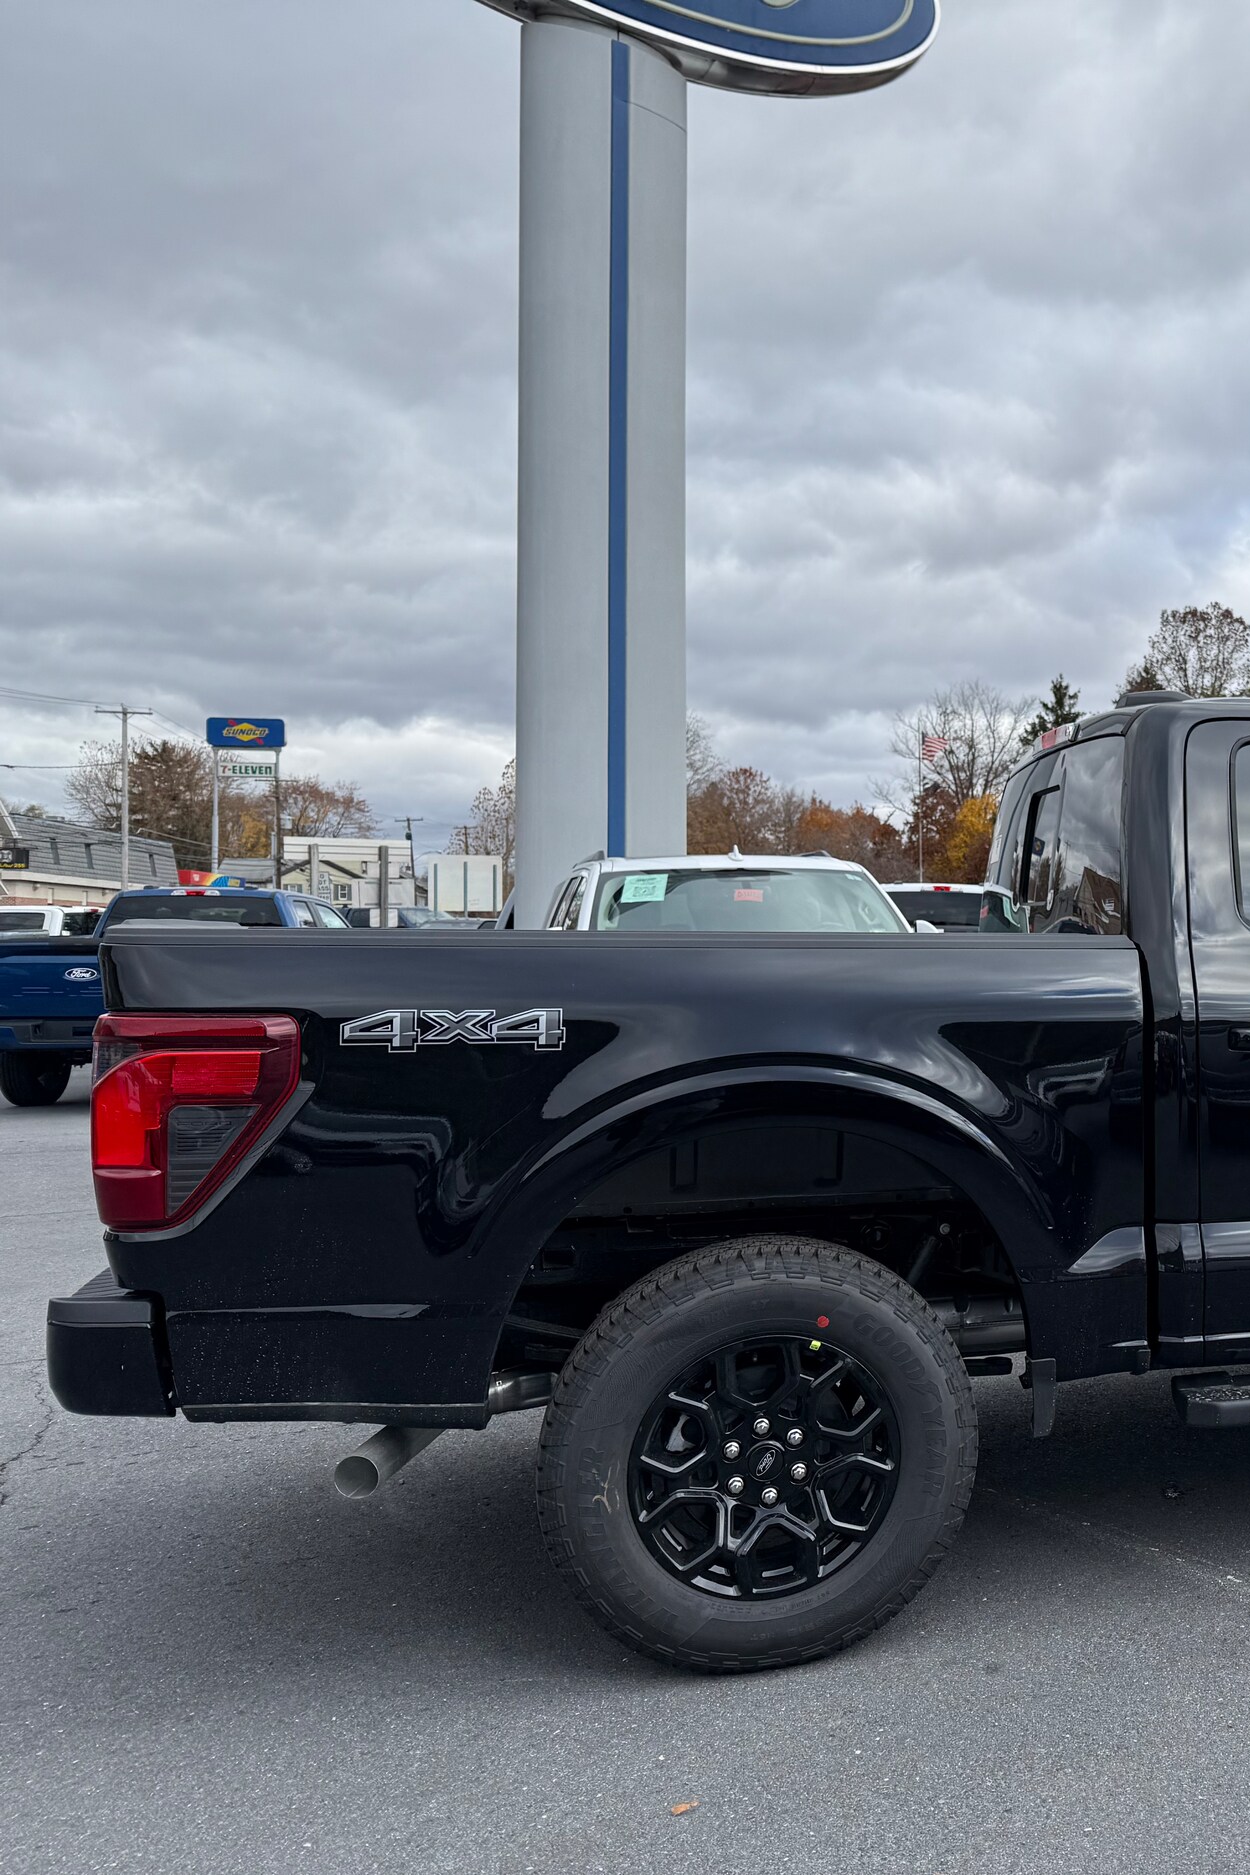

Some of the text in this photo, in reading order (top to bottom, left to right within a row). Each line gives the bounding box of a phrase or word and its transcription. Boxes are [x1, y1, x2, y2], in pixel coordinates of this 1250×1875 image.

[224, 728, 268, 737] SUNOCO
[70, 969, 92, 978] Ford
[853, 1312, 946, 1498] GOODYEAR
